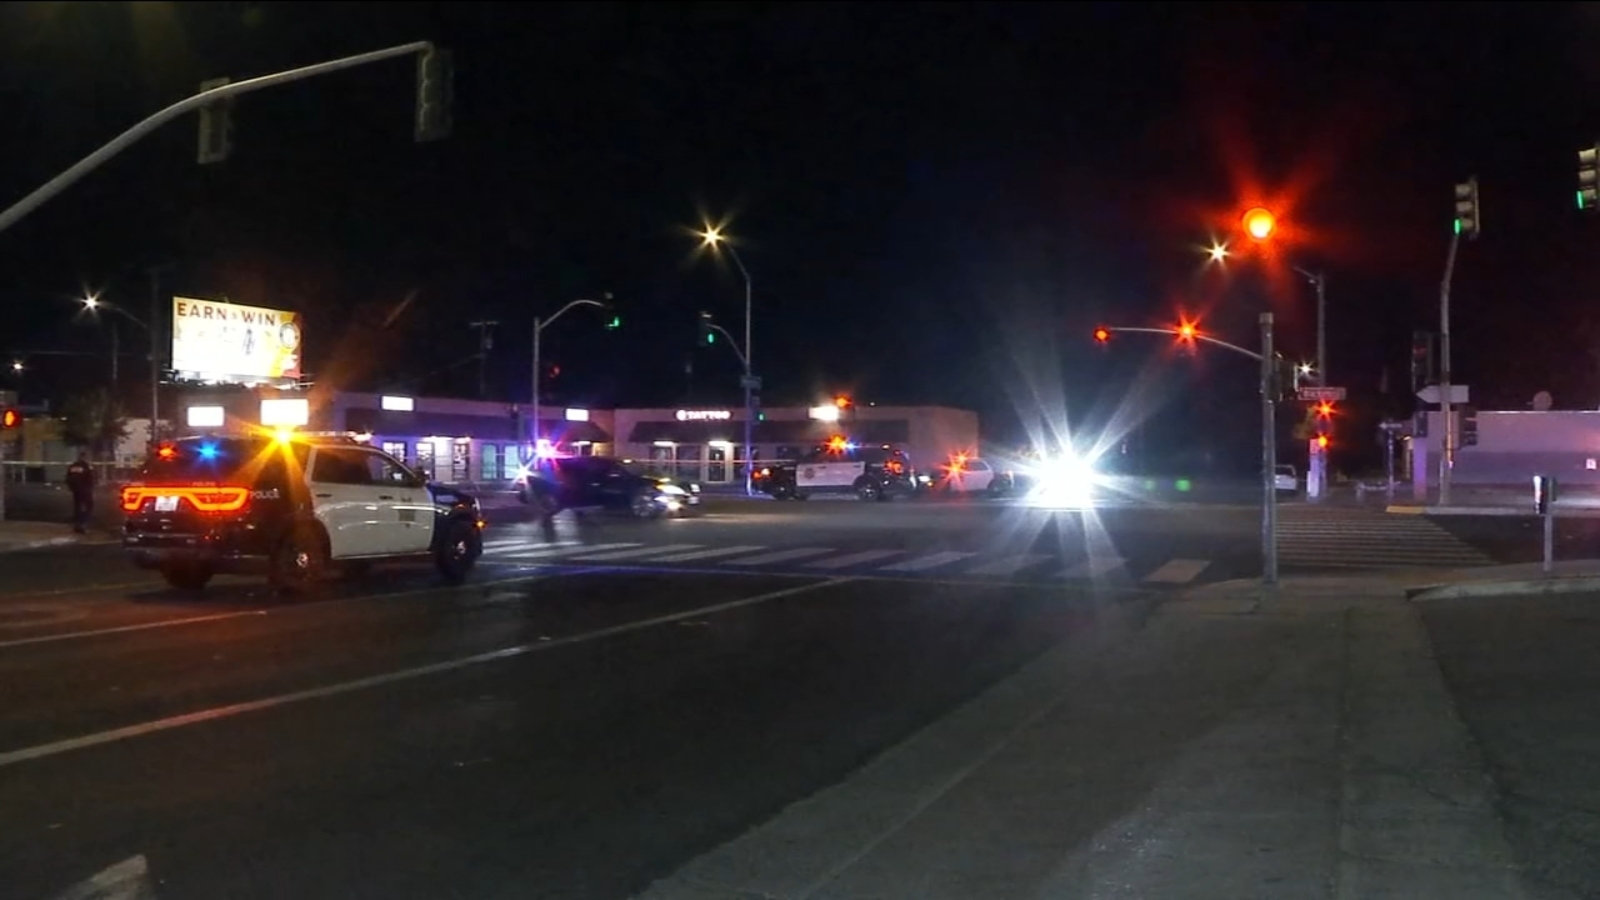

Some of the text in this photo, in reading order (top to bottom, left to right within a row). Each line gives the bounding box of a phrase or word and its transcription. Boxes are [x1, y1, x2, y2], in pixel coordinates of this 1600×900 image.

[177, 302, 227, 320] EARN
[240, 310, 276, 326] WIN
[686, 410, 730, 420] TATTOO
[250, 490, 280, 499] POLICE
